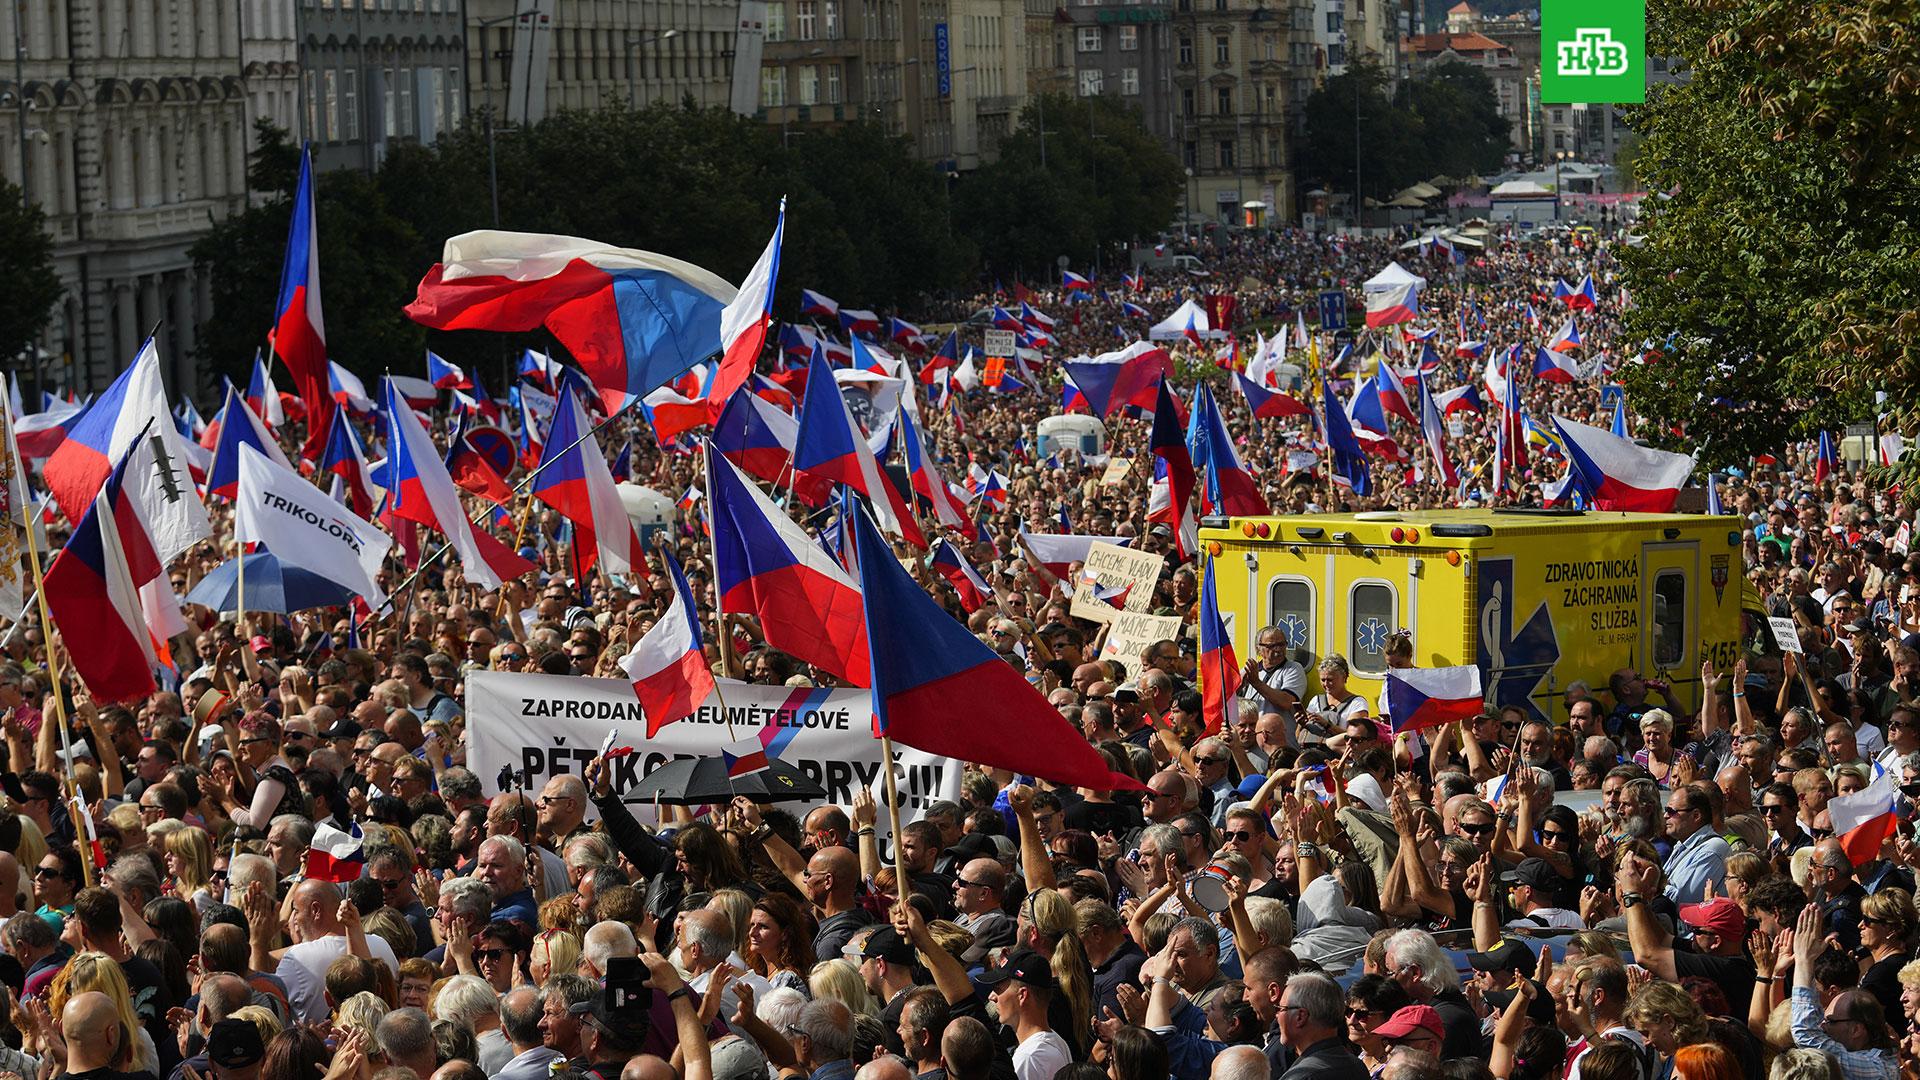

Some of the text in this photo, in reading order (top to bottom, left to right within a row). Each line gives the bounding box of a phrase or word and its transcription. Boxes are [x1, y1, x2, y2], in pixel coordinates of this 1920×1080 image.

[937, 27, 949, 95] ROKOKO
[263, 491, 361, 556] TRIKOLORA
[1545, 554, 1639, 583] ZDRAVOTNICKÁ
[1563, 579, 1639, 607] ZÁCHRANNÁ
[1591, 606, 1638, 631] SLUŽBA
[1616, 632, 1638, 643] PRAHY
[1710, 641, 1737, 670] 155
[522, 699, 644, 721] ZAPRODAN
